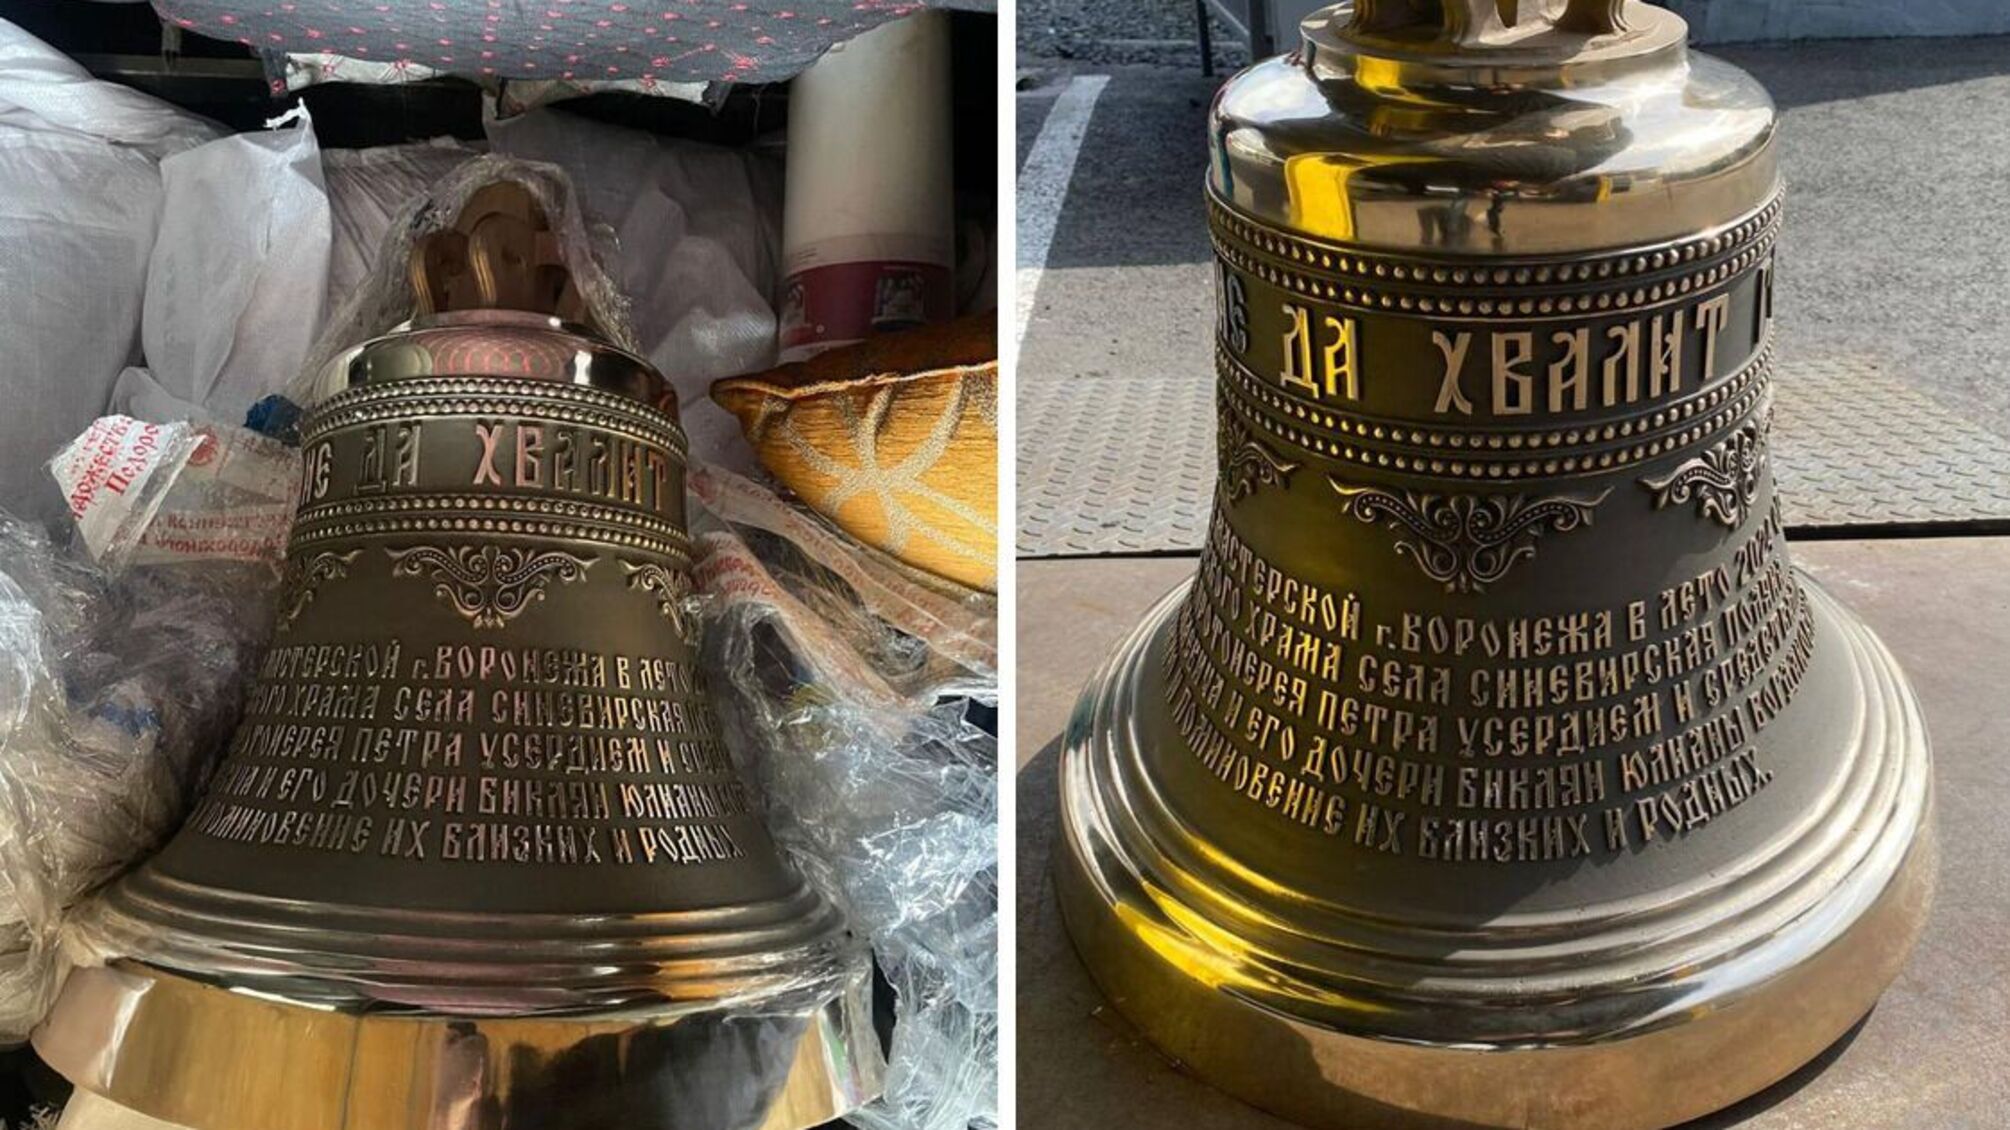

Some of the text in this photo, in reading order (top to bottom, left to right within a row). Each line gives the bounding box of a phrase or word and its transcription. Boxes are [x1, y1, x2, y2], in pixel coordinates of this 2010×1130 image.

[1279, 304, 1359, 400] ДА
[1432, 293, 1730, 415] ХВАЛИТ
[353, 425, 421, 494] ДА
[472, 424, 666, 511] ХВАЛИТ
[1629, 602, 1647, 642] В
[1661, 564, 1730, 630] ЛЕТО
[616, 656, 631, 690] В
[639, 658, 690, 693] ЛЕТО
[1245, 601, 1341, 682] ХРАМА
[1359, 655, 1449, 705] СЕЛА
[1470, 621, 1718, 708] СИНЕВИРСКАЯ
[288, 684, 381, 720] ХРАМА
[394, 686, 475, 724] СЕЛА
[491, 689, 687, 733] СИНЕВИРСКАЯ
[1318, 691, 1438, 752] ПЕТРА
[1458, 692, 1661, 758] УСЕРДИЕМ
[1673, 680, 1694, 722] И
[351, 727, 463, 768] ПЕТРА
[480, 732, 650, 775] УСЕРДИЕМ
[657, 739, 676, 775] И
[1224, 690, 1244, 729] И
[1246, 707, 1295, 761] ЕГО
[1301, 736, 1444, 807] ДОЧЕРИ
[256, 766, 278, 799] И
[278, 768, 327, 801] ЕГО
[330, 770, 467, 813] ДОЧЕРИ
[381, 818, 431, 858] ИХ
[443, 822, 601, 864] БЛИЗКИХ
[613, 828, 634, 864] И
[1355, 802, 1404, 854] ИХ
[1419, 813, 1591, 862] БЛИЗКИХ
[1605, 808, 1628, 850] И
